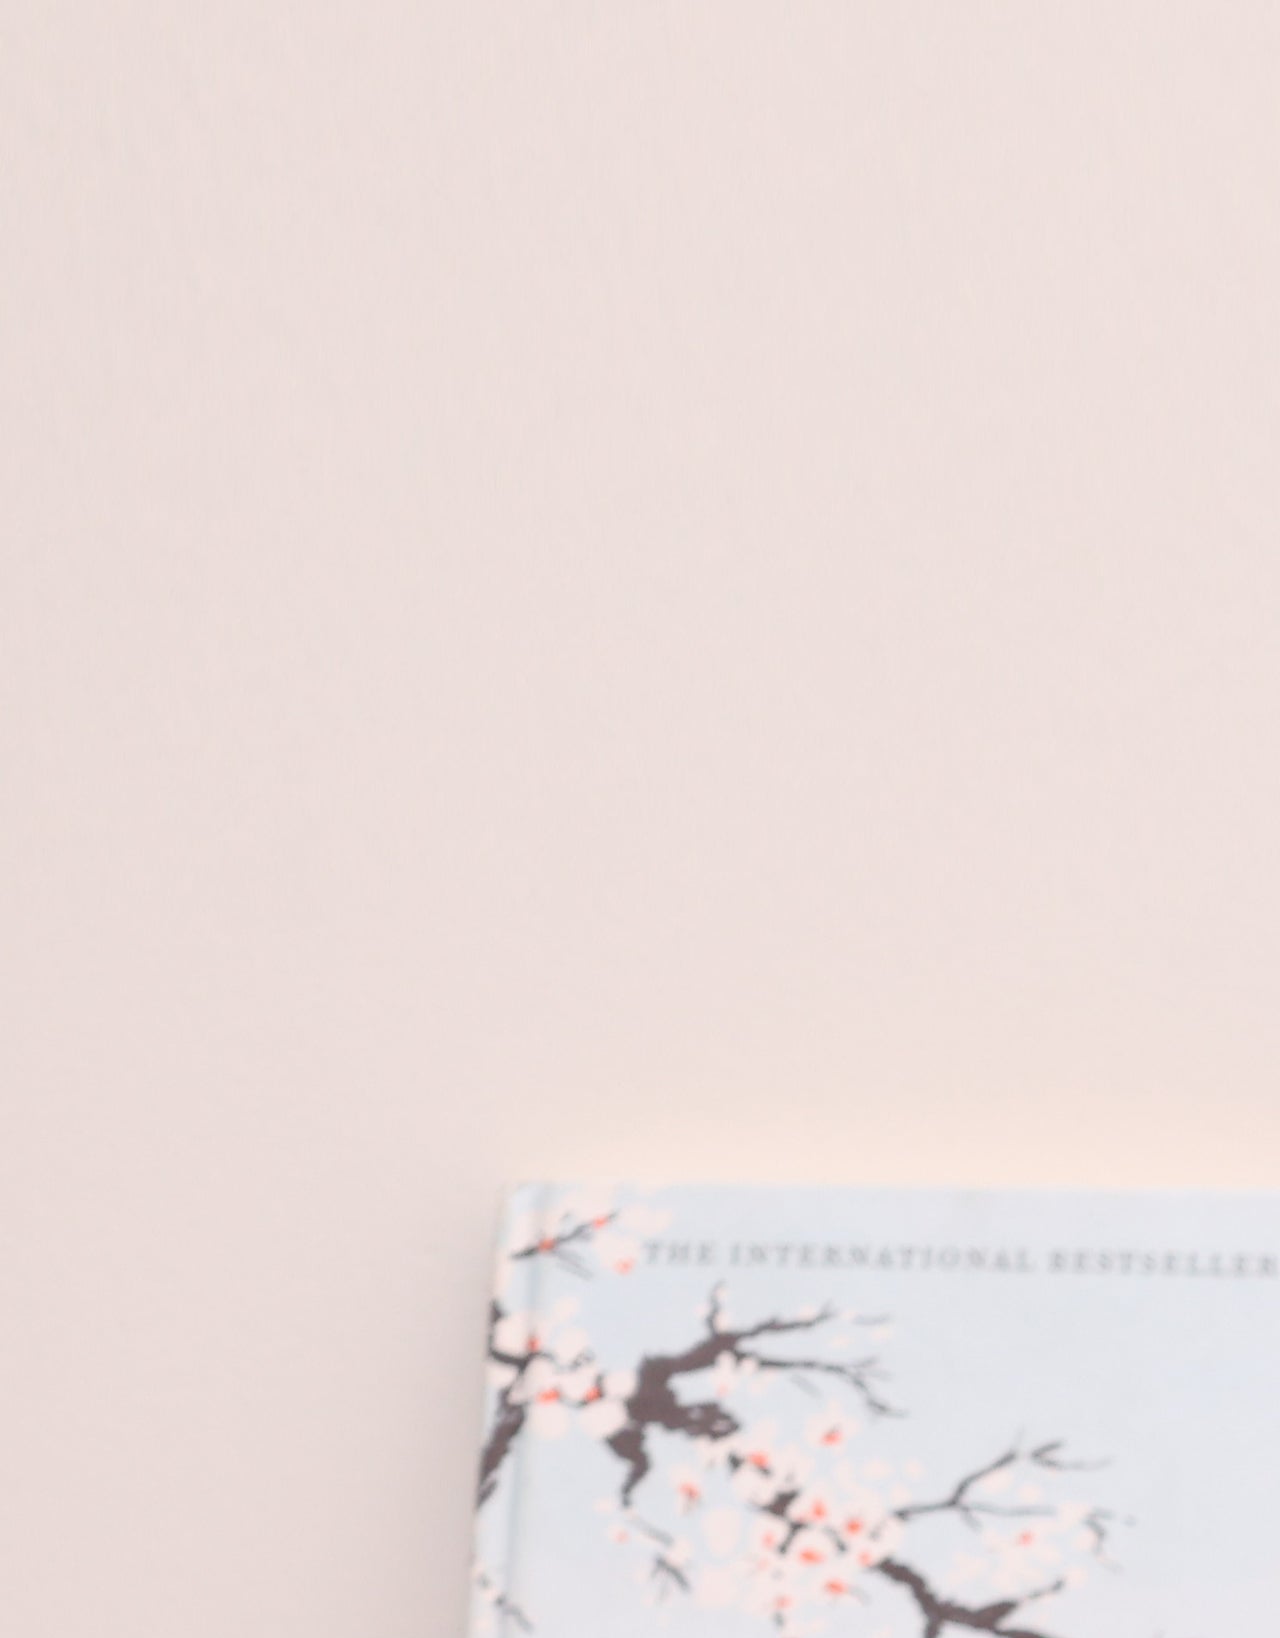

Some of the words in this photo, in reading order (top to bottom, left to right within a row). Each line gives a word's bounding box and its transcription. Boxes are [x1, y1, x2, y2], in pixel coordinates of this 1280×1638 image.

[645, 1240, 716, 1264] THE
[729, 1242, 1034, 1273] INTERNATIONAL
[1047, 1250, 1280, 1278] BESTSELLER
